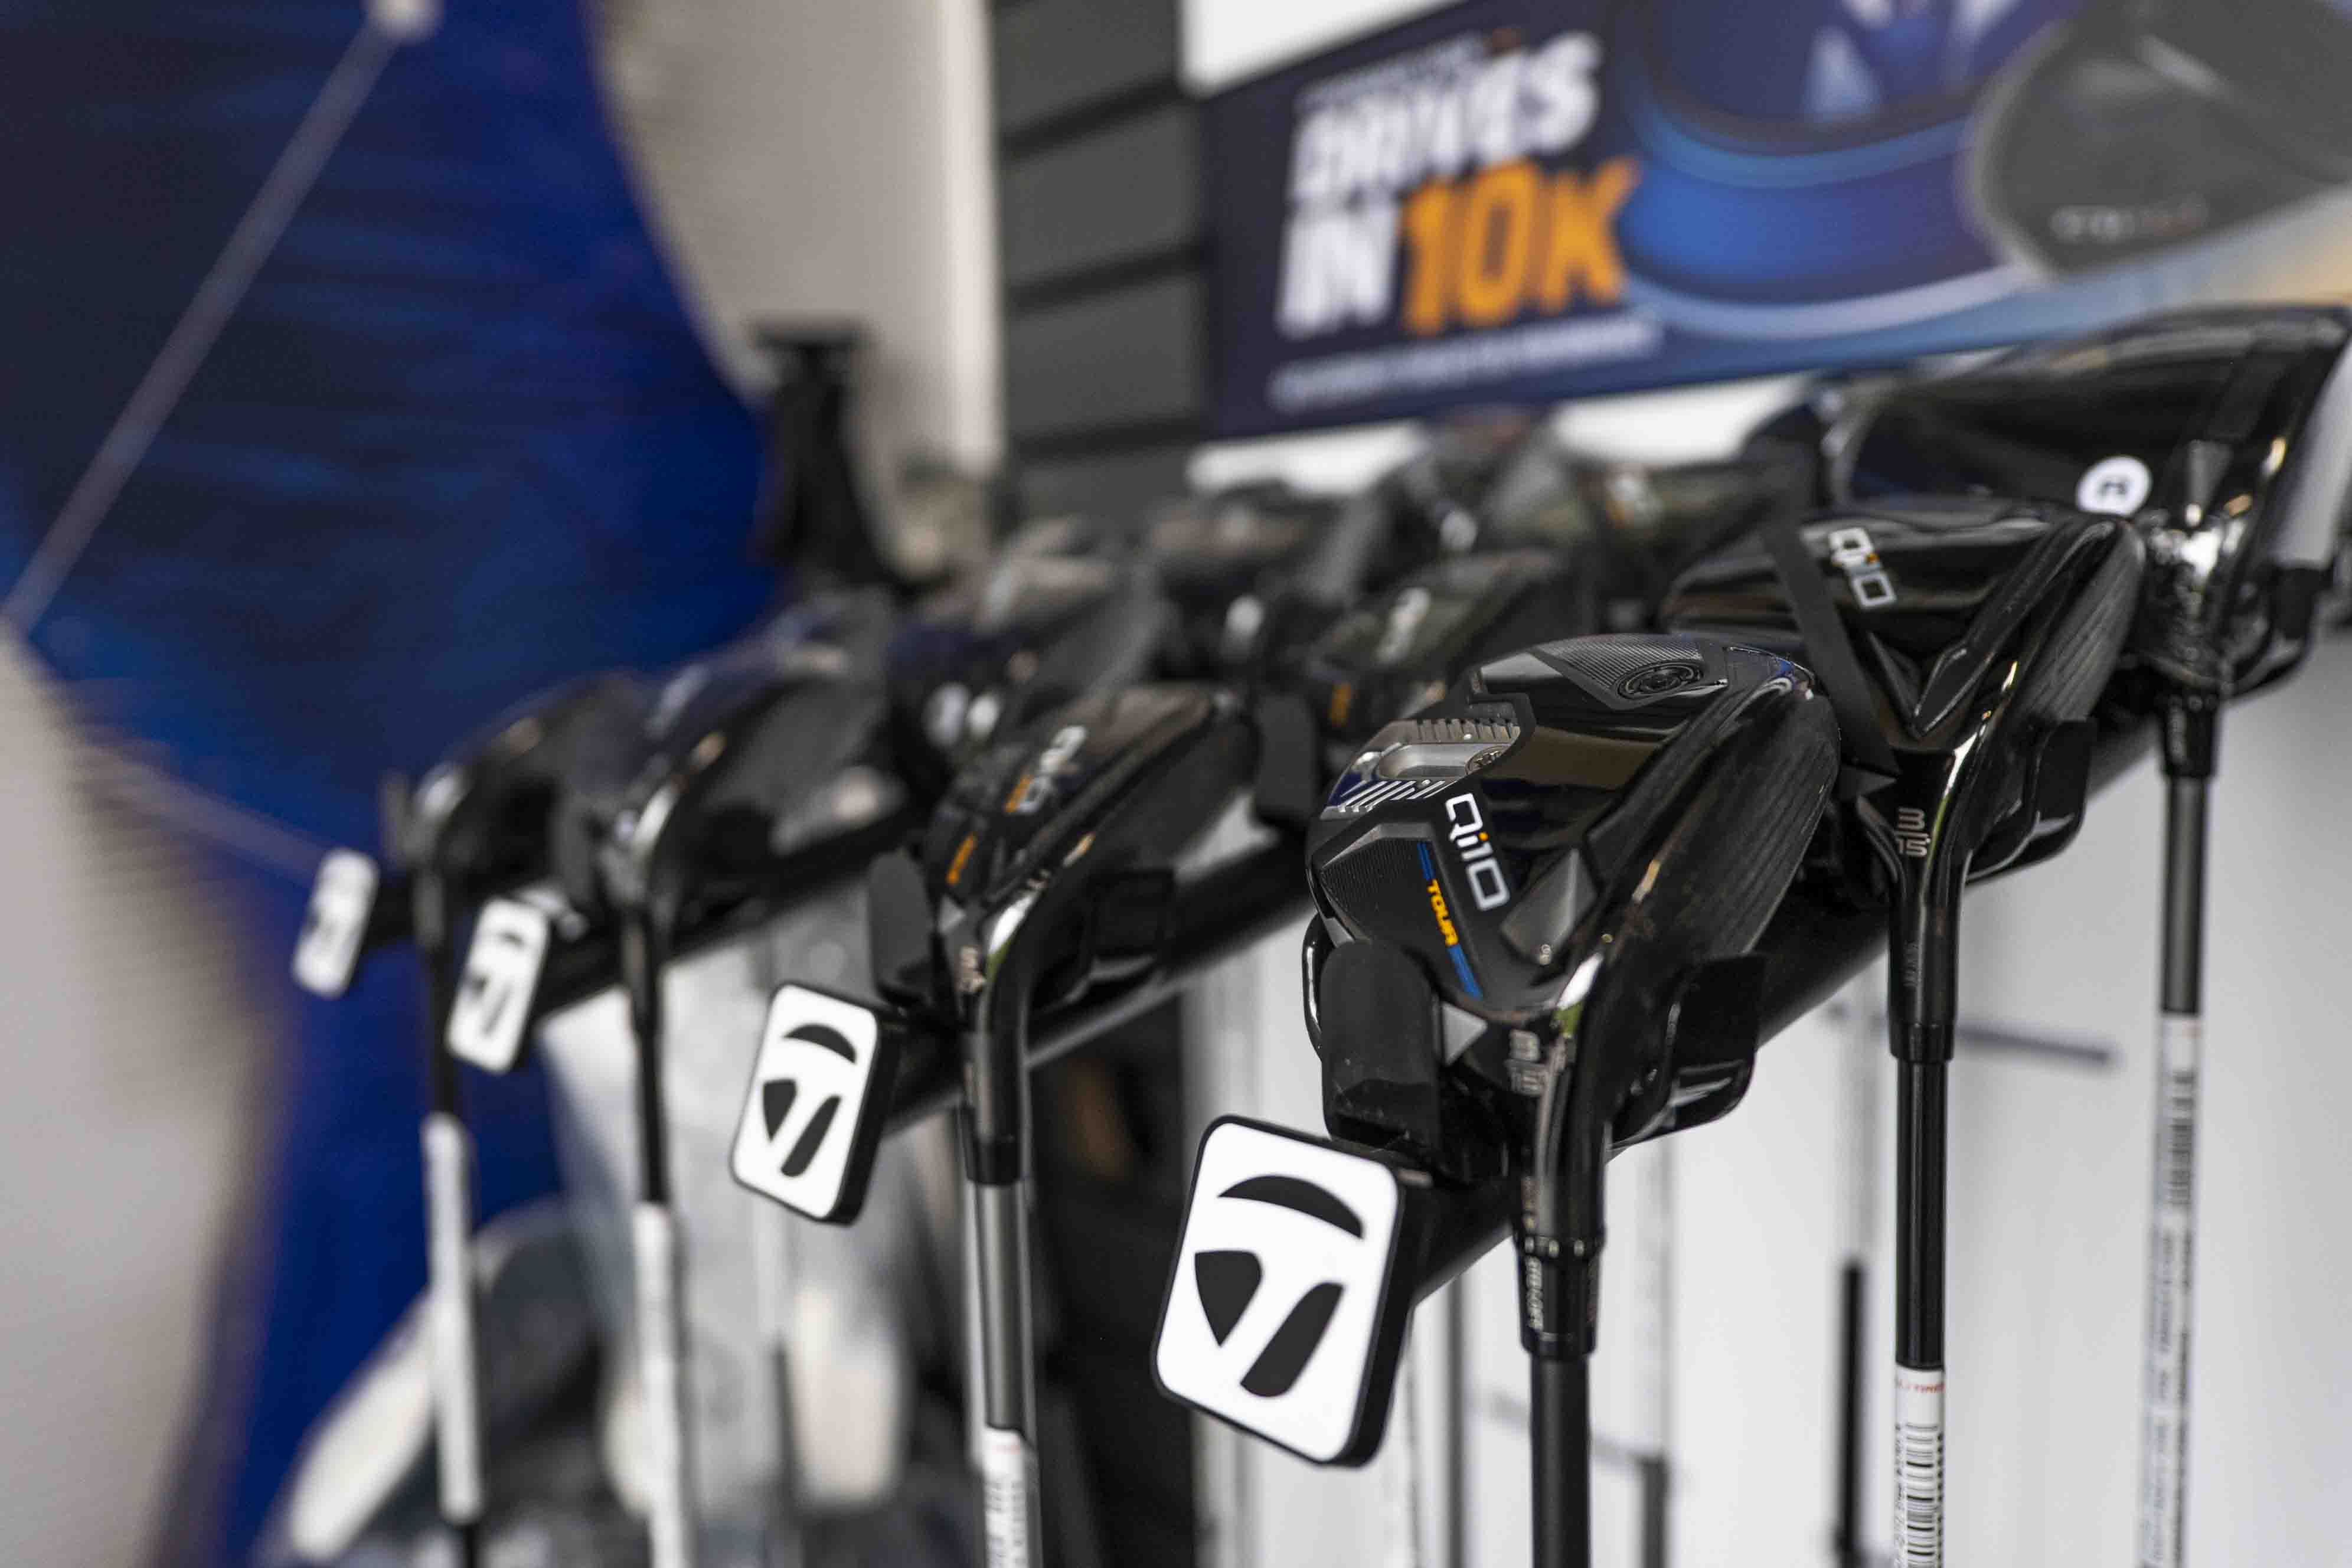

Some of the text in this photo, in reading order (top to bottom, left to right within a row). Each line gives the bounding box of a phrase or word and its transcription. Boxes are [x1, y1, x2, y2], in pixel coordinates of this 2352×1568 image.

[1403, 156, 1640, 335] 10K
[1445, 792, 1510, 912] Qi10
[1427, 878, 1459, 947] TOUR
